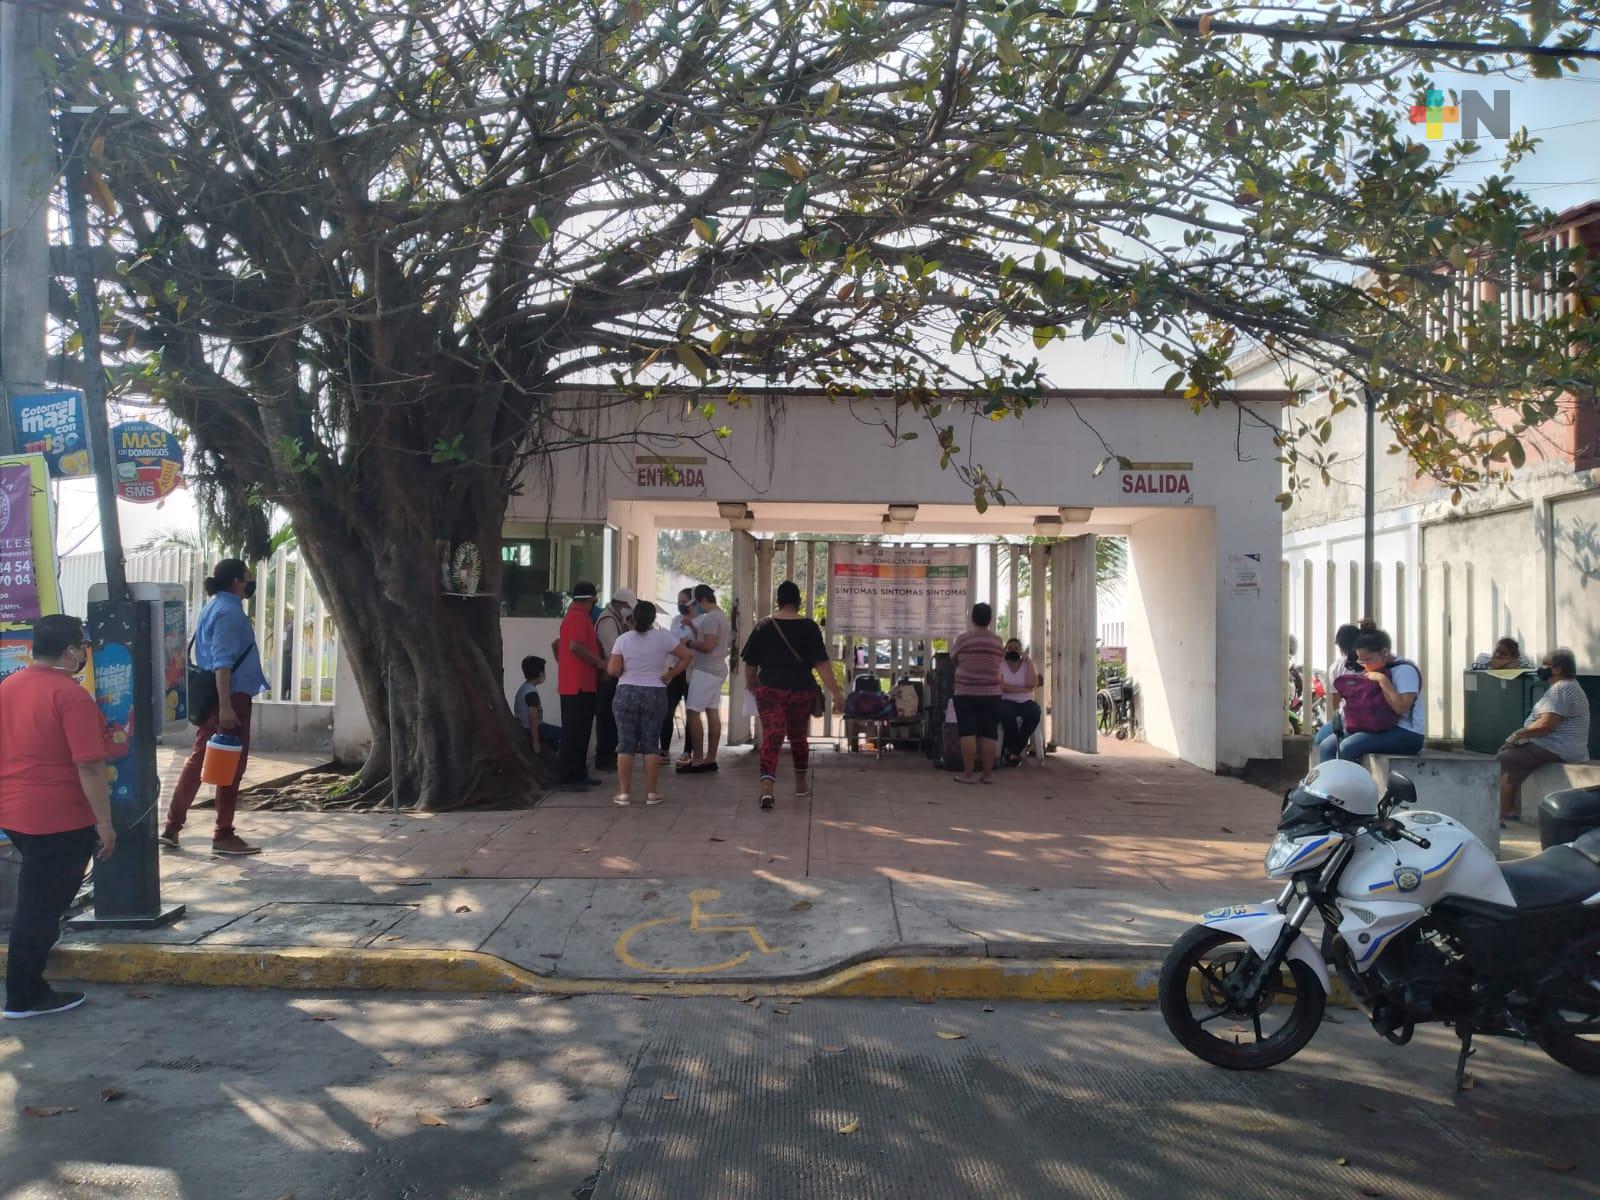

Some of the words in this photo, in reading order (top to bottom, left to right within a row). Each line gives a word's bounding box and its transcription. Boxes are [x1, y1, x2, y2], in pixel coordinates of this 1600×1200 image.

[21, 400, 68, 417] Cotorrea
[55, 423, 76, 434] con
[1122, 474, 1190, 493] SALIDA
[125, 486, 154, 497] SMS
[15, 560, 31, 572] 54
[15, 574, 31, 585] 04
